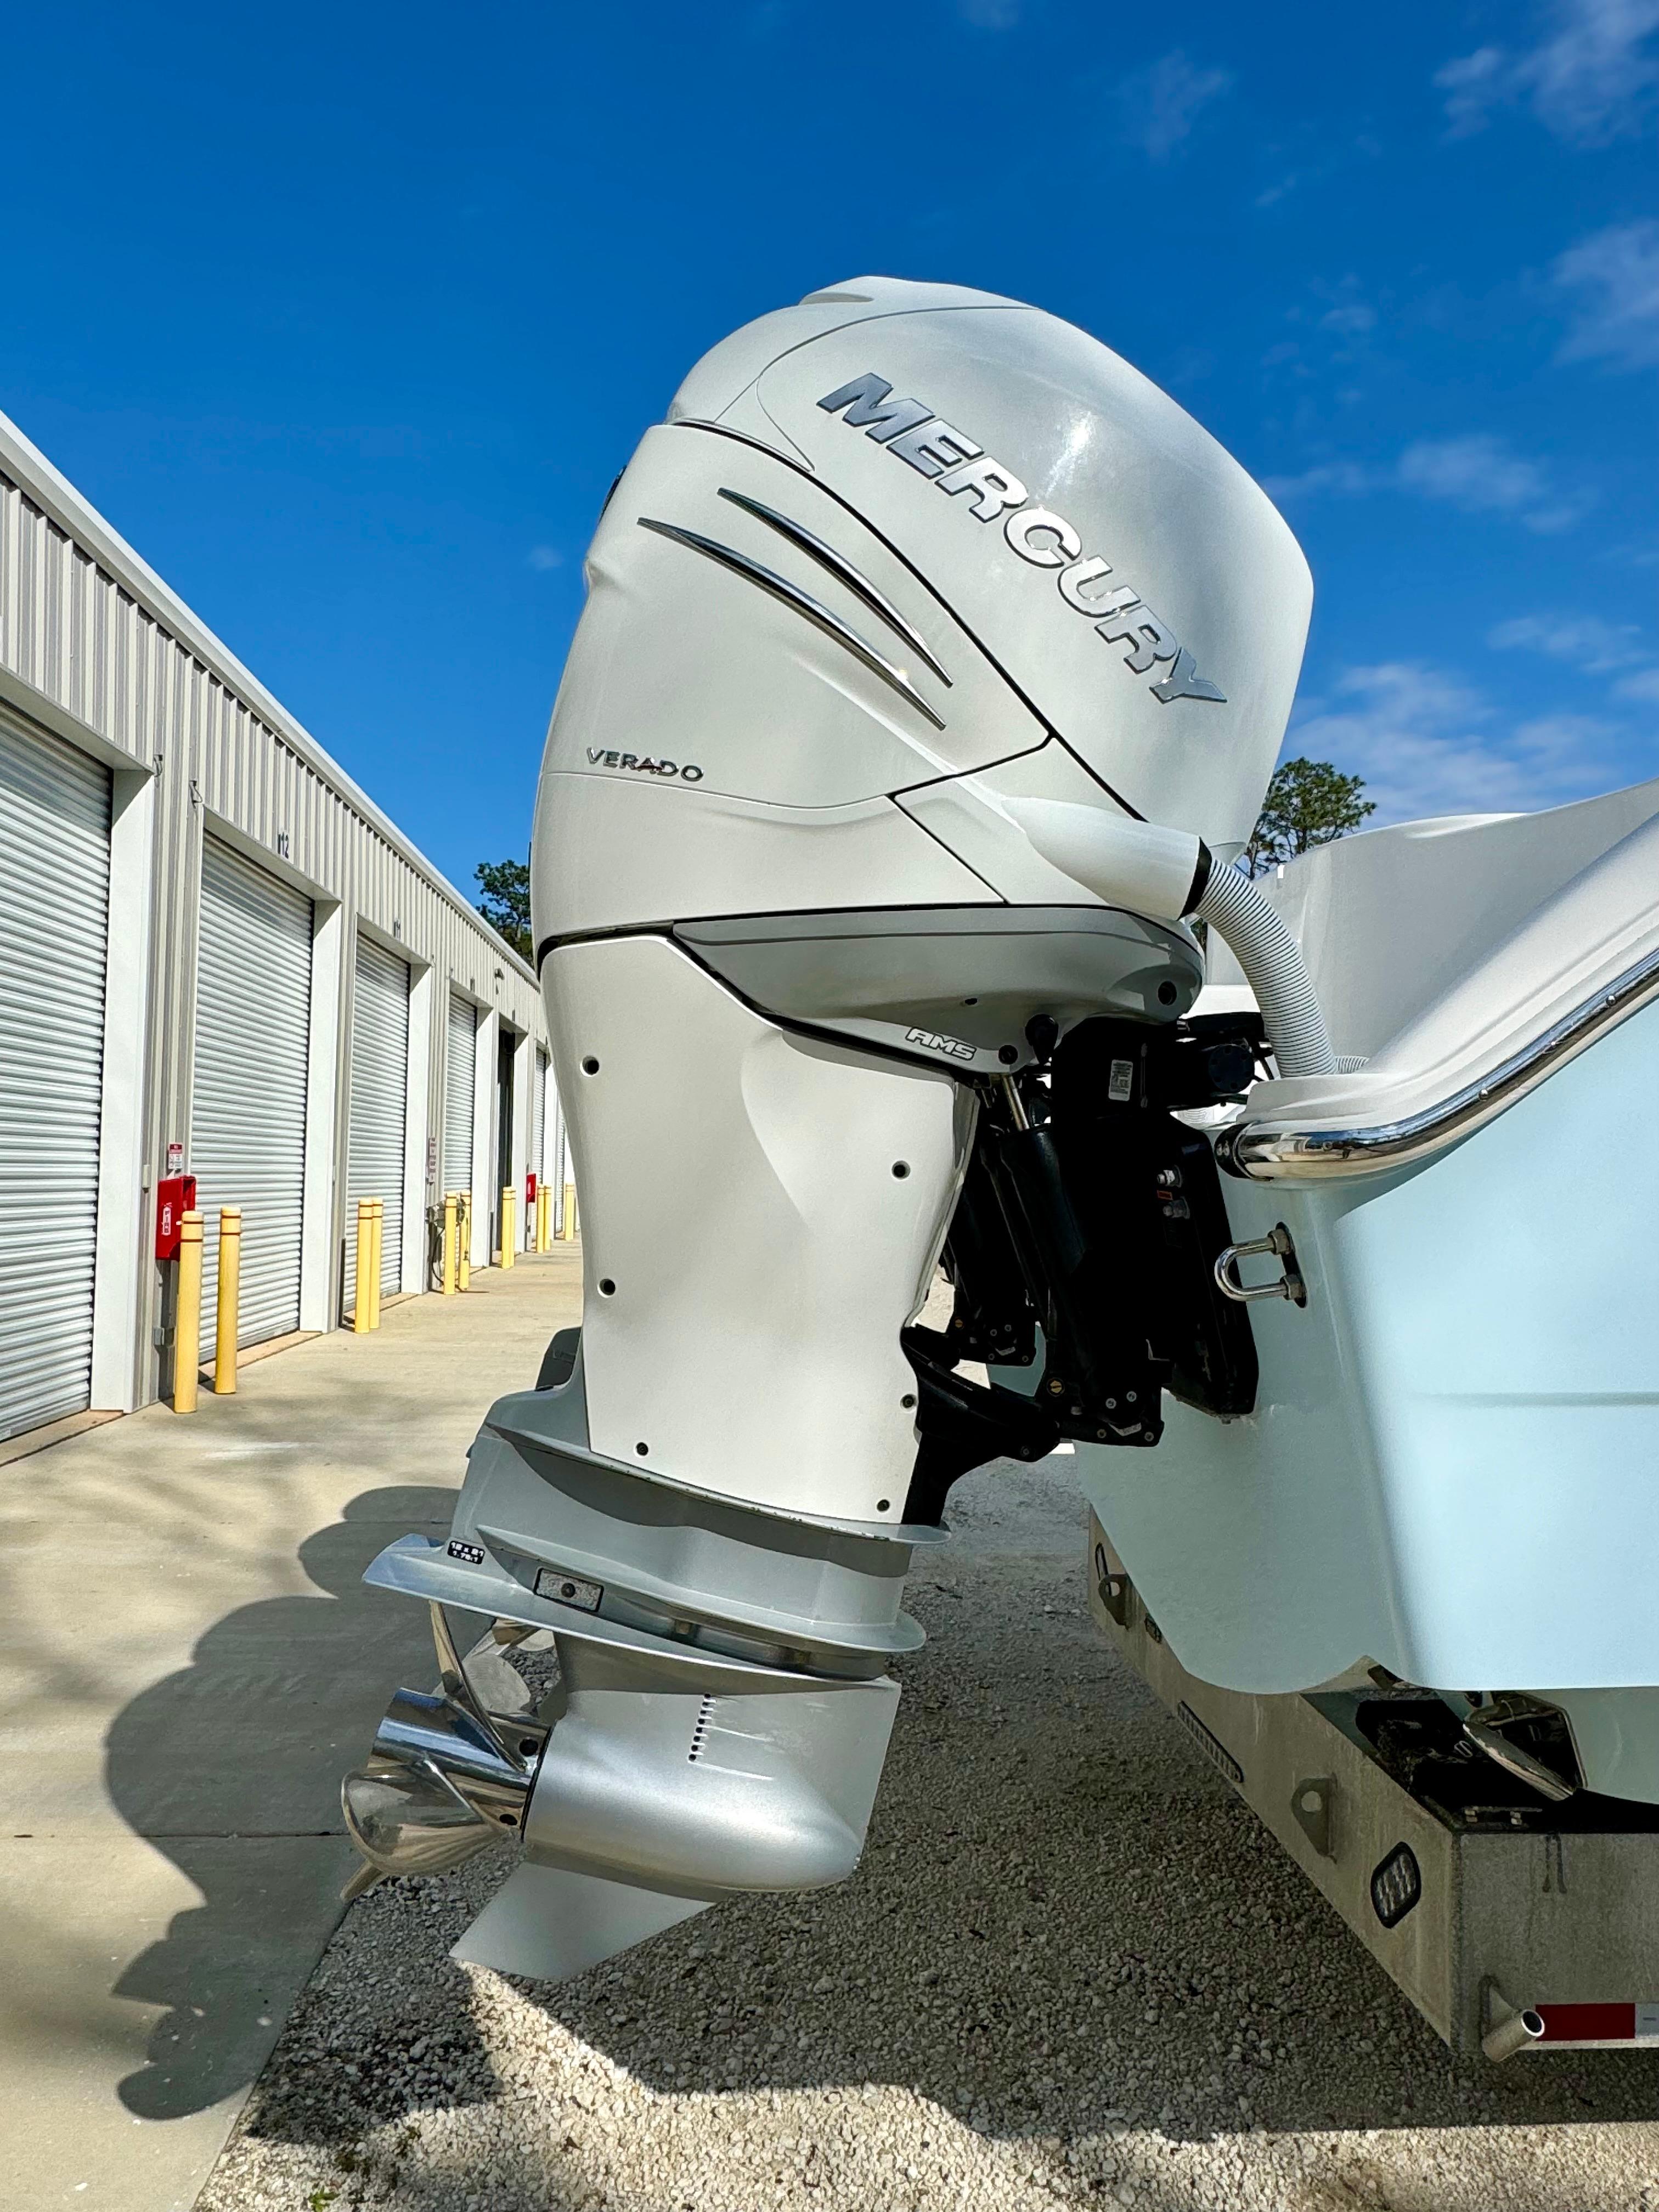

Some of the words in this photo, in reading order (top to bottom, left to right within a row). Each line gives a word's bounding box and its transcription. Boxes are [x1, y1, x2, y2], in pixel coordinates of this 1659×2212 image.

[816, 372, 1227, 704] MERCURY
[586, 747, 704, 782] VERADO
[905, 1026, 977, 1060] AMS
